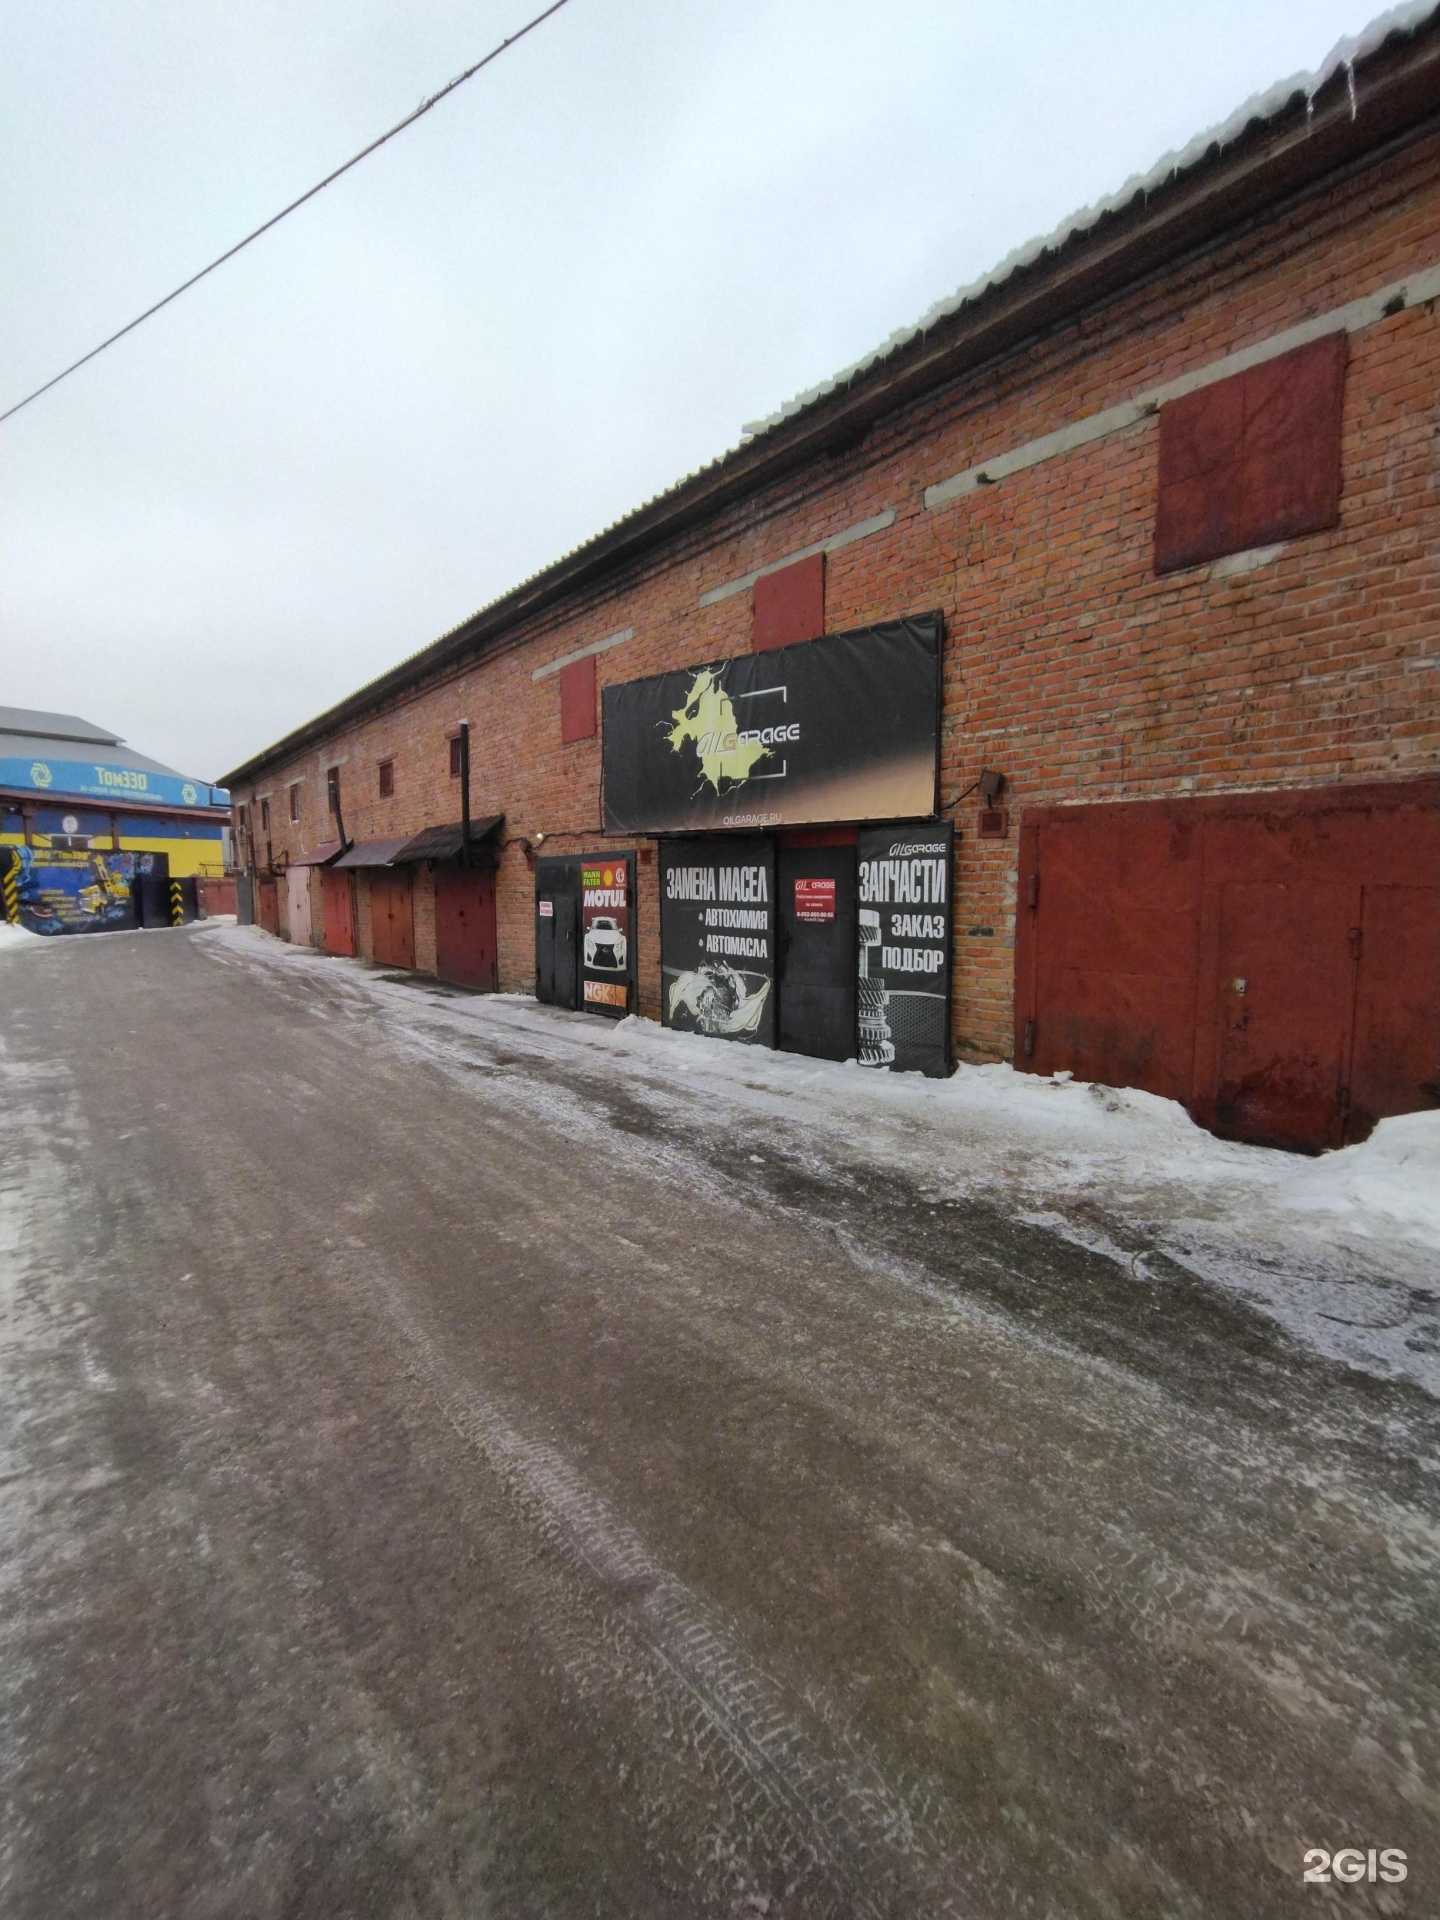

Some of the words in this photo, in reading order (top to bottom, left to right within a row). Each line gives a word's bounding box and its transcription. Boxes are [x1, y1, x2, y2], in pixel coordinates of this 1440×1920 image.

[666, 867, 716, 901] ЗАМЕНА
[719, 866, 768, 902] МАСЕЛ
[859, 859, 946, 903] ЗАПЧАСТИ
[583, 888, 627, 908] MOTUL
[705, 908, 768, 930] АВТОХИМИЯ
[891, 914, 945, 939] ЗАКАЗ
[706, 934, 768, 958] АВТОМАСЛА
[882, 946, 944, 973] ПОДБОР
